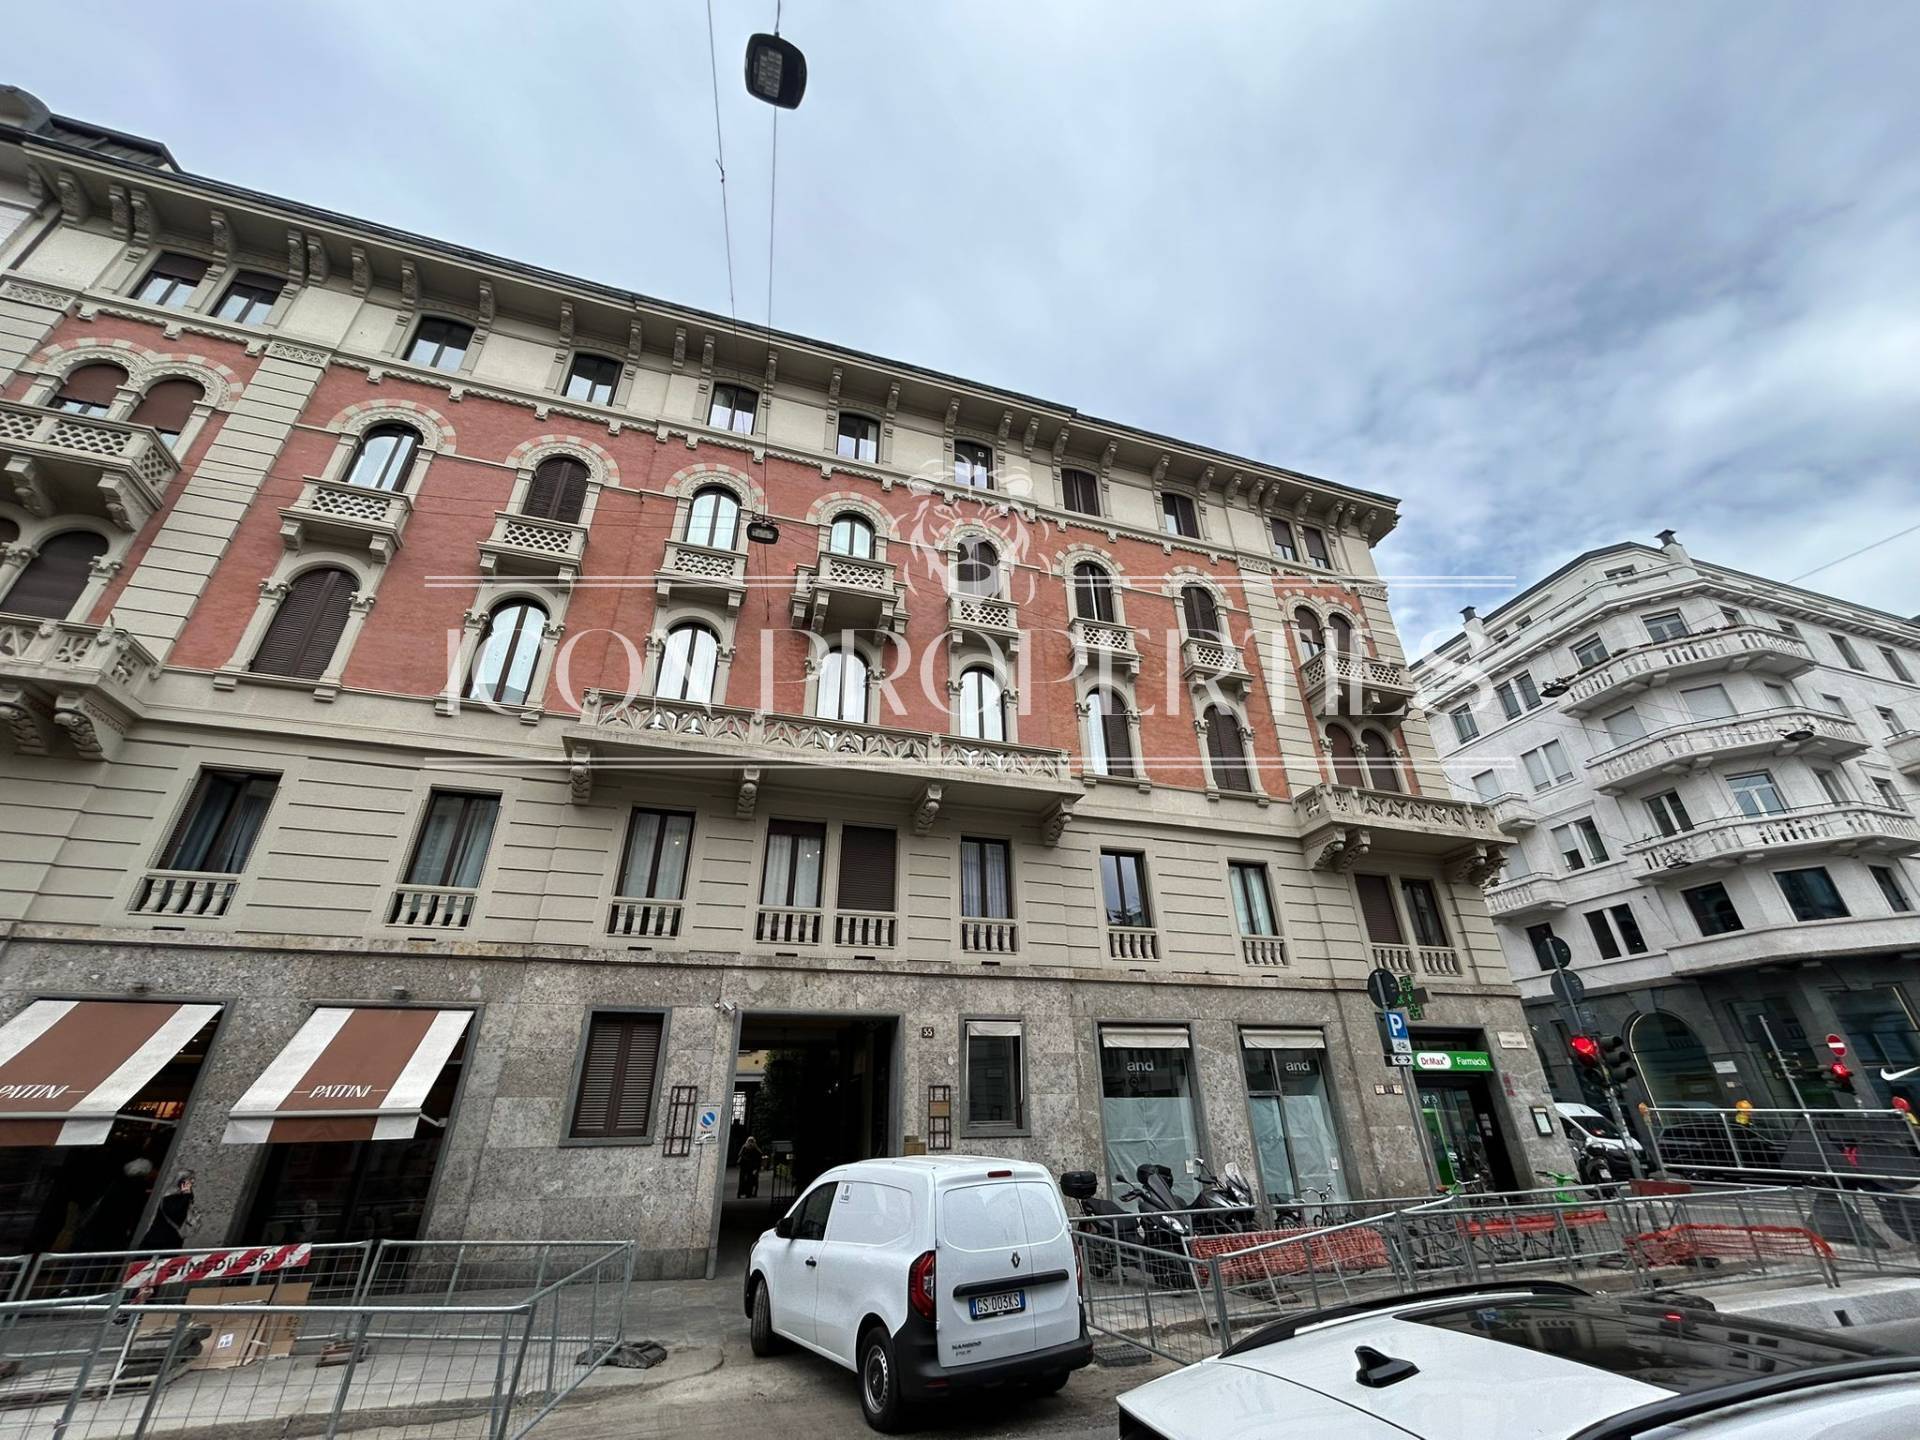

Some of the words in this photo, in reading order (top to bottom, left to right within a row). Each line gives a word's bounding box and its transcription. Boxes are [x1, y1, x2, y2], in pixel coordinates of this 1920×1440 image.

[1388, 1013, 1403, 1036] P
[1127, 1060, 1154, 1072] and
[1285, 1060, 1310, 1071] and
[1456, 1056, 1487, 1066] Farmacia
[309, 1085, 373, 1099] PATTINI
[977, 1298, 989, 1312] GS
